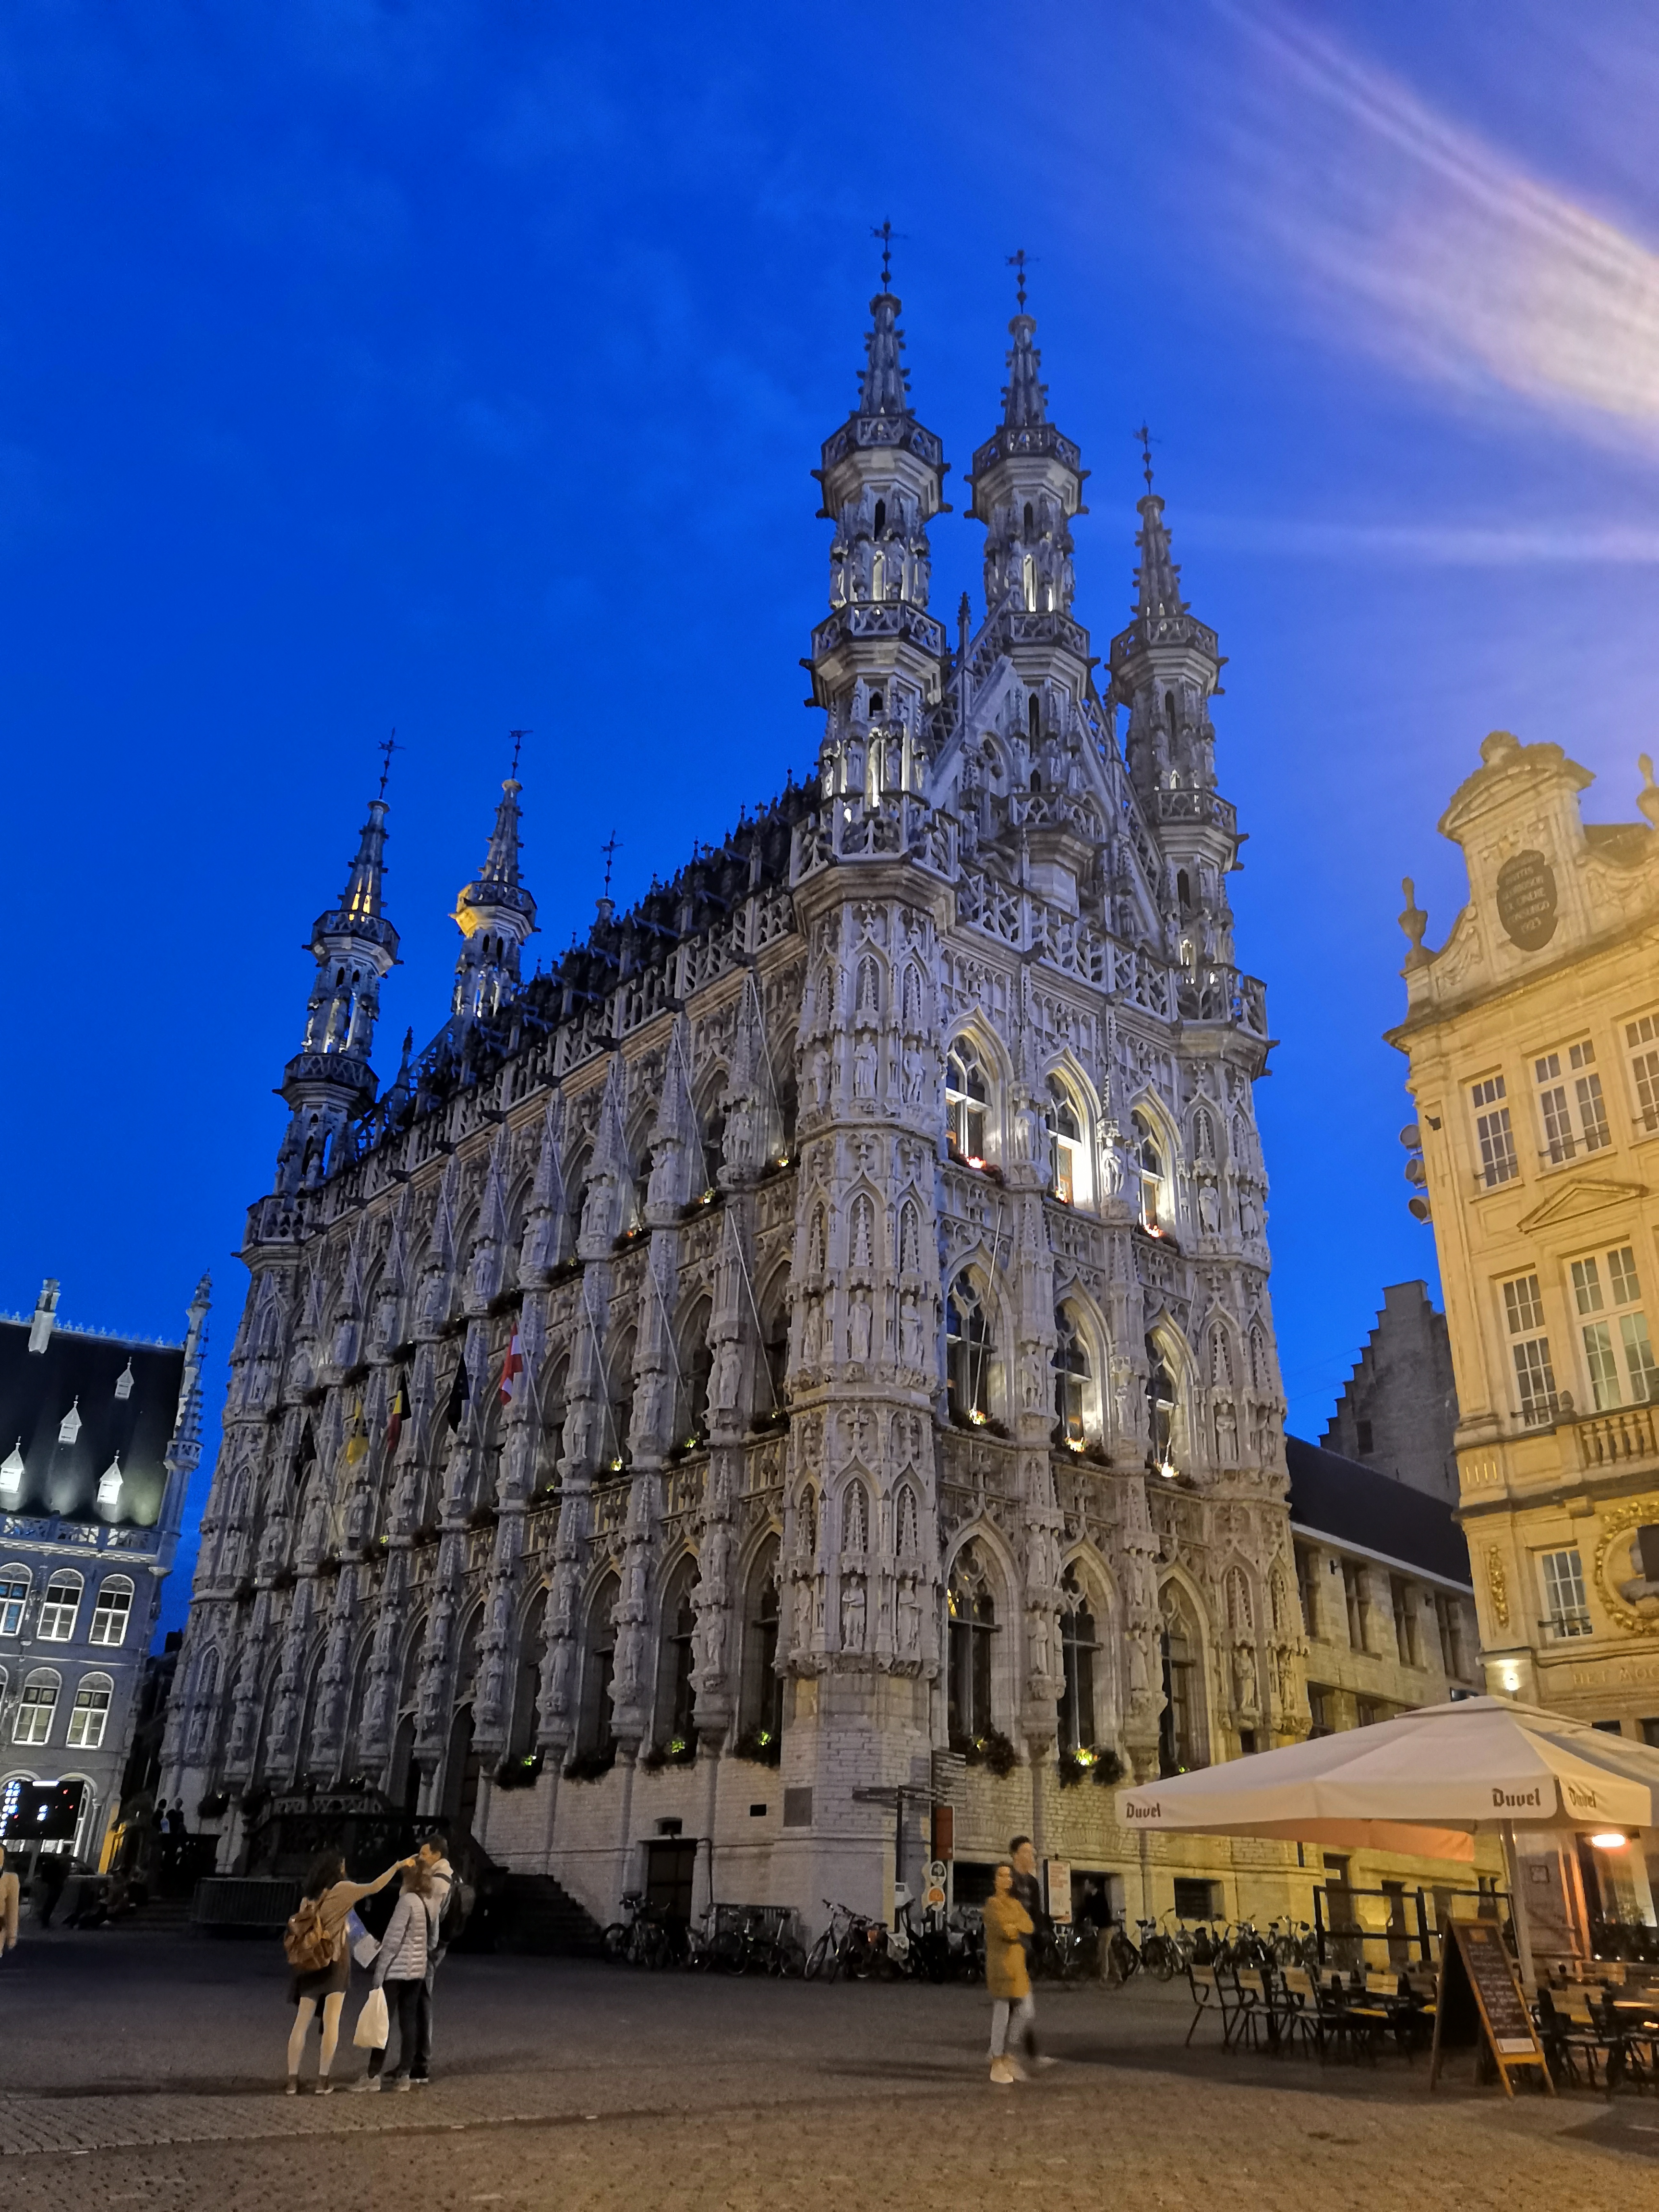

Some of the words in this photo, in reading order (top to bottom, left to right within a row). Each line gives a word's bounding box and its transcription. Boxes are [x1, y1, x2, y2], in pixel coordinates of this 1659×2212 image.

[1492, 1788, 1540, 1807] Duvel
[1568, 1787, 1596, 1808] Duvel
[1126, 1802, 1161, 1818] Duvel
